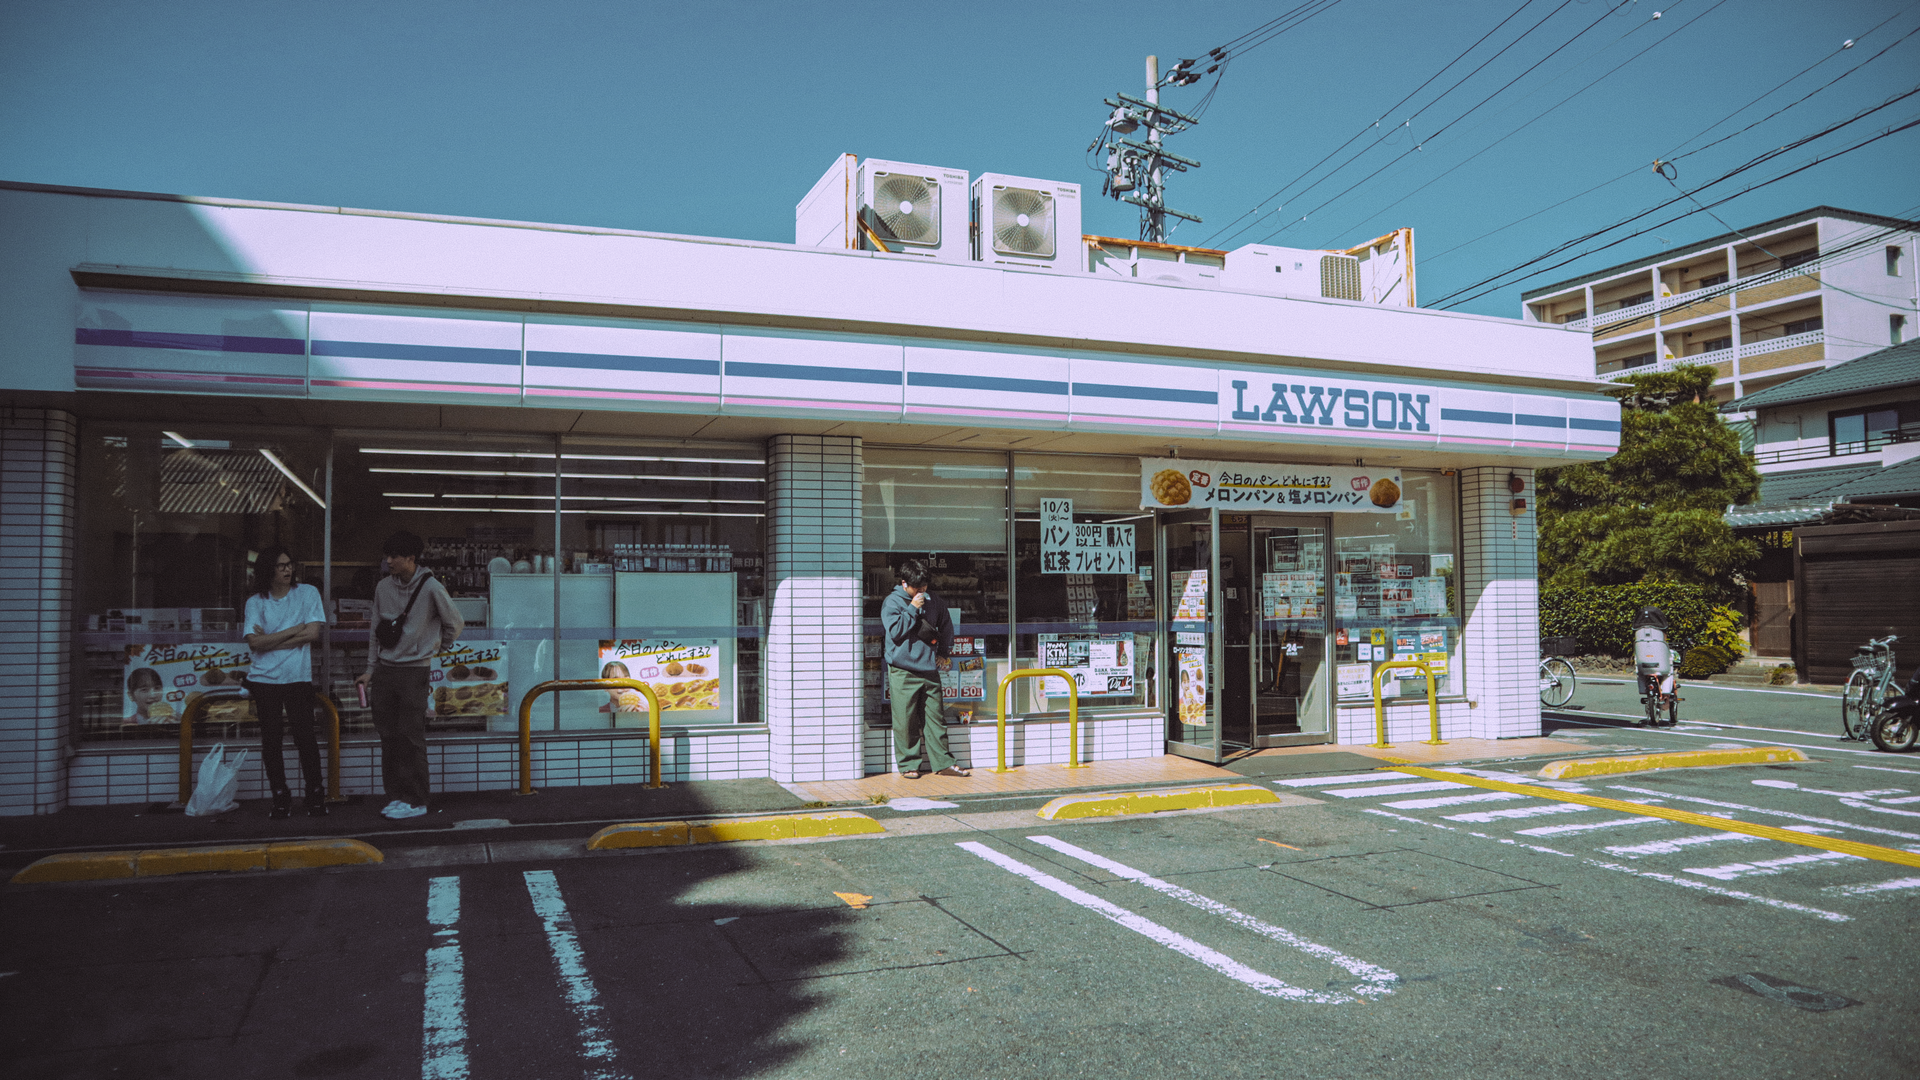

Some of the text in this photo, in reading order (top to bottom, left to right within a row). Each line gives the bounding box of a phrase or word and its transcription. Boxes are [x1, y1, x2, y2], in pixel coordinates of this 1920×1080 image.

[1232, 380, 1430, 431] LAWSON
[1043, 501, 1069, 513] 10/3
[1388, 590, 1408, 600] ATM
[1286, 643, 1297, 652] 24
[1047, 649, 1067, 657] KTM
[963, 687, 977, 697] 50
